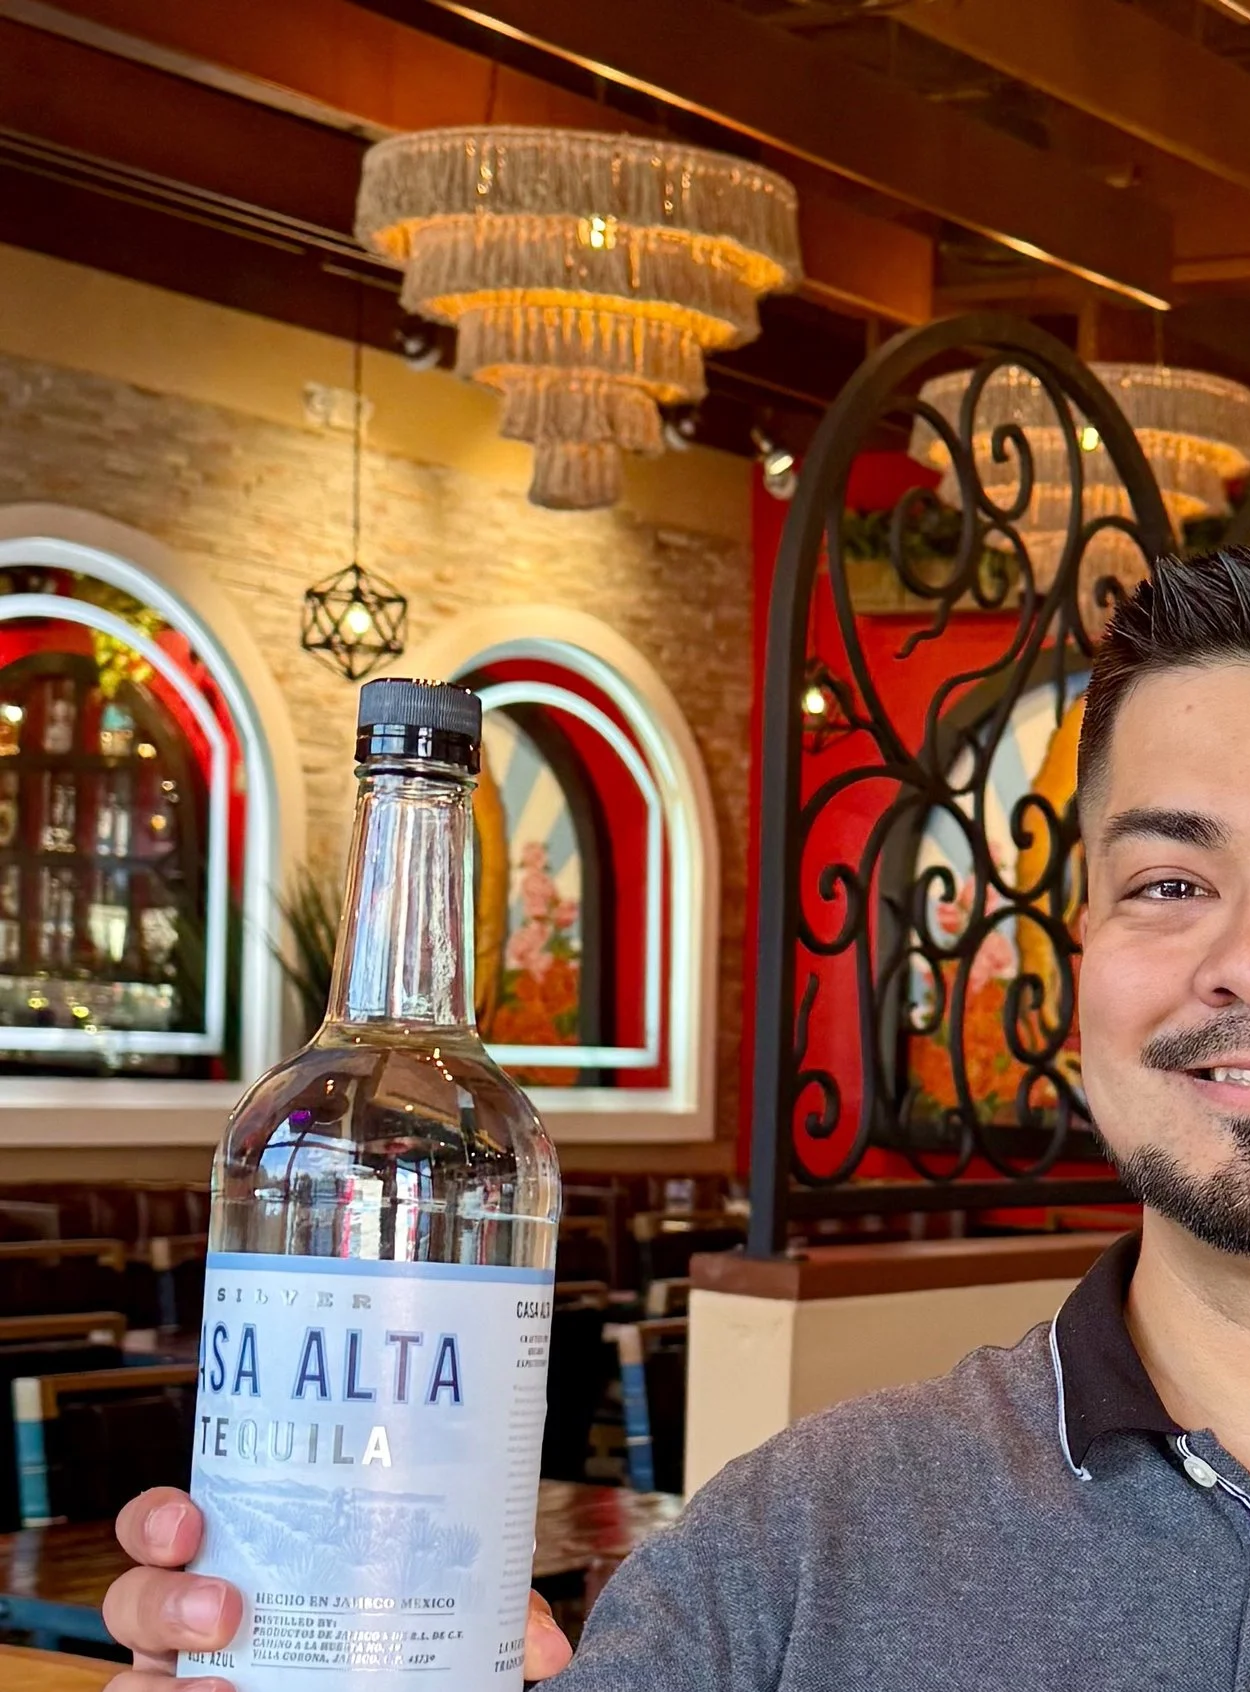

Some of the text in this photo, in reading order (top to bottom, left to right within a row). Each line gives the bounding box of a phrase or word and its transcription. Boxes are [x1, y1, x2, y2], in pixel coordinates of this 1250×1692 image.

[217, 1287, 372, 1310] SILVER
[290, 1326, 464, 1406] ALTA
[201, 1415, 392, 1468] TEQUILA
[255, 1591, 305, 1607] HECHO
[310, 1595, 329, 1608] EN
[400, 1597, 455, 1609] MEXICO
[254, 1614, 314, 1627] DISTILLED
[253, 1626, 315, 1639] PRODUCTOS
[317, 1630, 333, 1640] DE
[209, 1651, 235, 1669] AZUL
